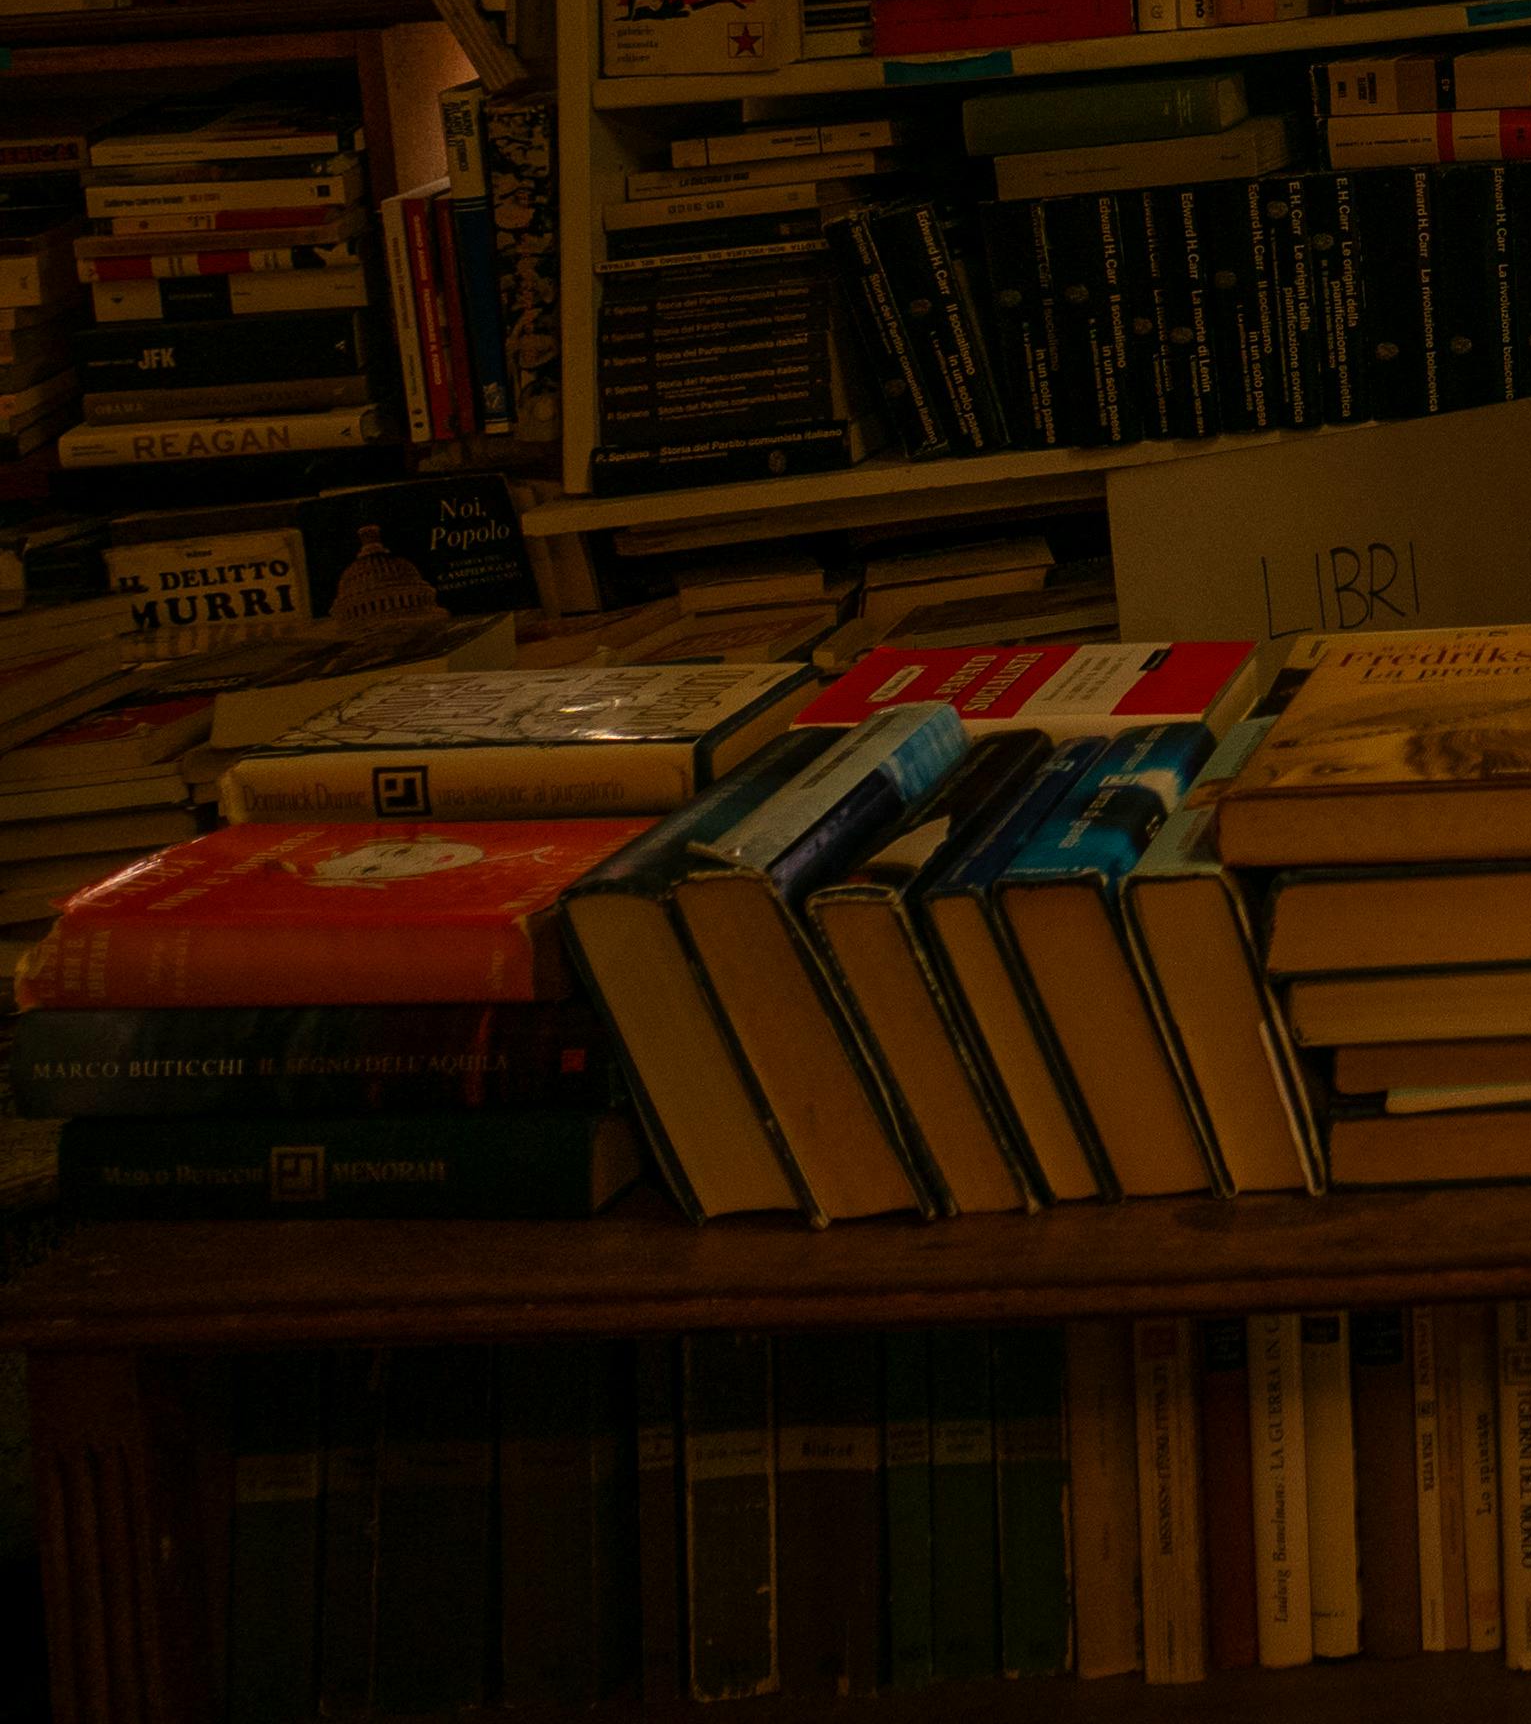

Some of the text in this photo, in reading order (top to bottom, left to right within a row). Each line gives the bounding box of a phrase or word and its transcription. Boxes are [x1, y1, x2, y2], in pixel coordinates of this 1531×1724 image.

[1414, 172, 1428, 216] Edward
[1180, 192, 1195, 237] Edward
[1338, 205, 1351, 232] Carr
[1340, 240, 1354, 258] Le
[1417, 232, 1431, 258] Carr
[1186, 253, 1200, 281] Carr
[1341, 259, 1356, 296] origini
[1420, 268, 1432, 283] La
[1191, 289, 1203, 305] La
[1345, 298, 1358, 328] della
[1192, 307, 1207, 343] morte
[1419, 286, 1435, 349] rivoluzione
[138, 347, 177, 370] JFK
[1281, 286, 1304, 424] pianificazione sovietica
[1329, 280, 1352, 418] pianificazione sovietica
[1199, 359, 1213, 393] Lenin
[1425, 351, 1439, 412] bolscevica
[133, 425, 292, 461] REAGAN
[440, 496, 487, 522] Noi,
[429, 520, 511, 552] Popolo
[160, 560, 290, 591] DELITTO
[1260, 541, 1422, 639] LIBRI
[131, 585, 295, 630] MURRI
